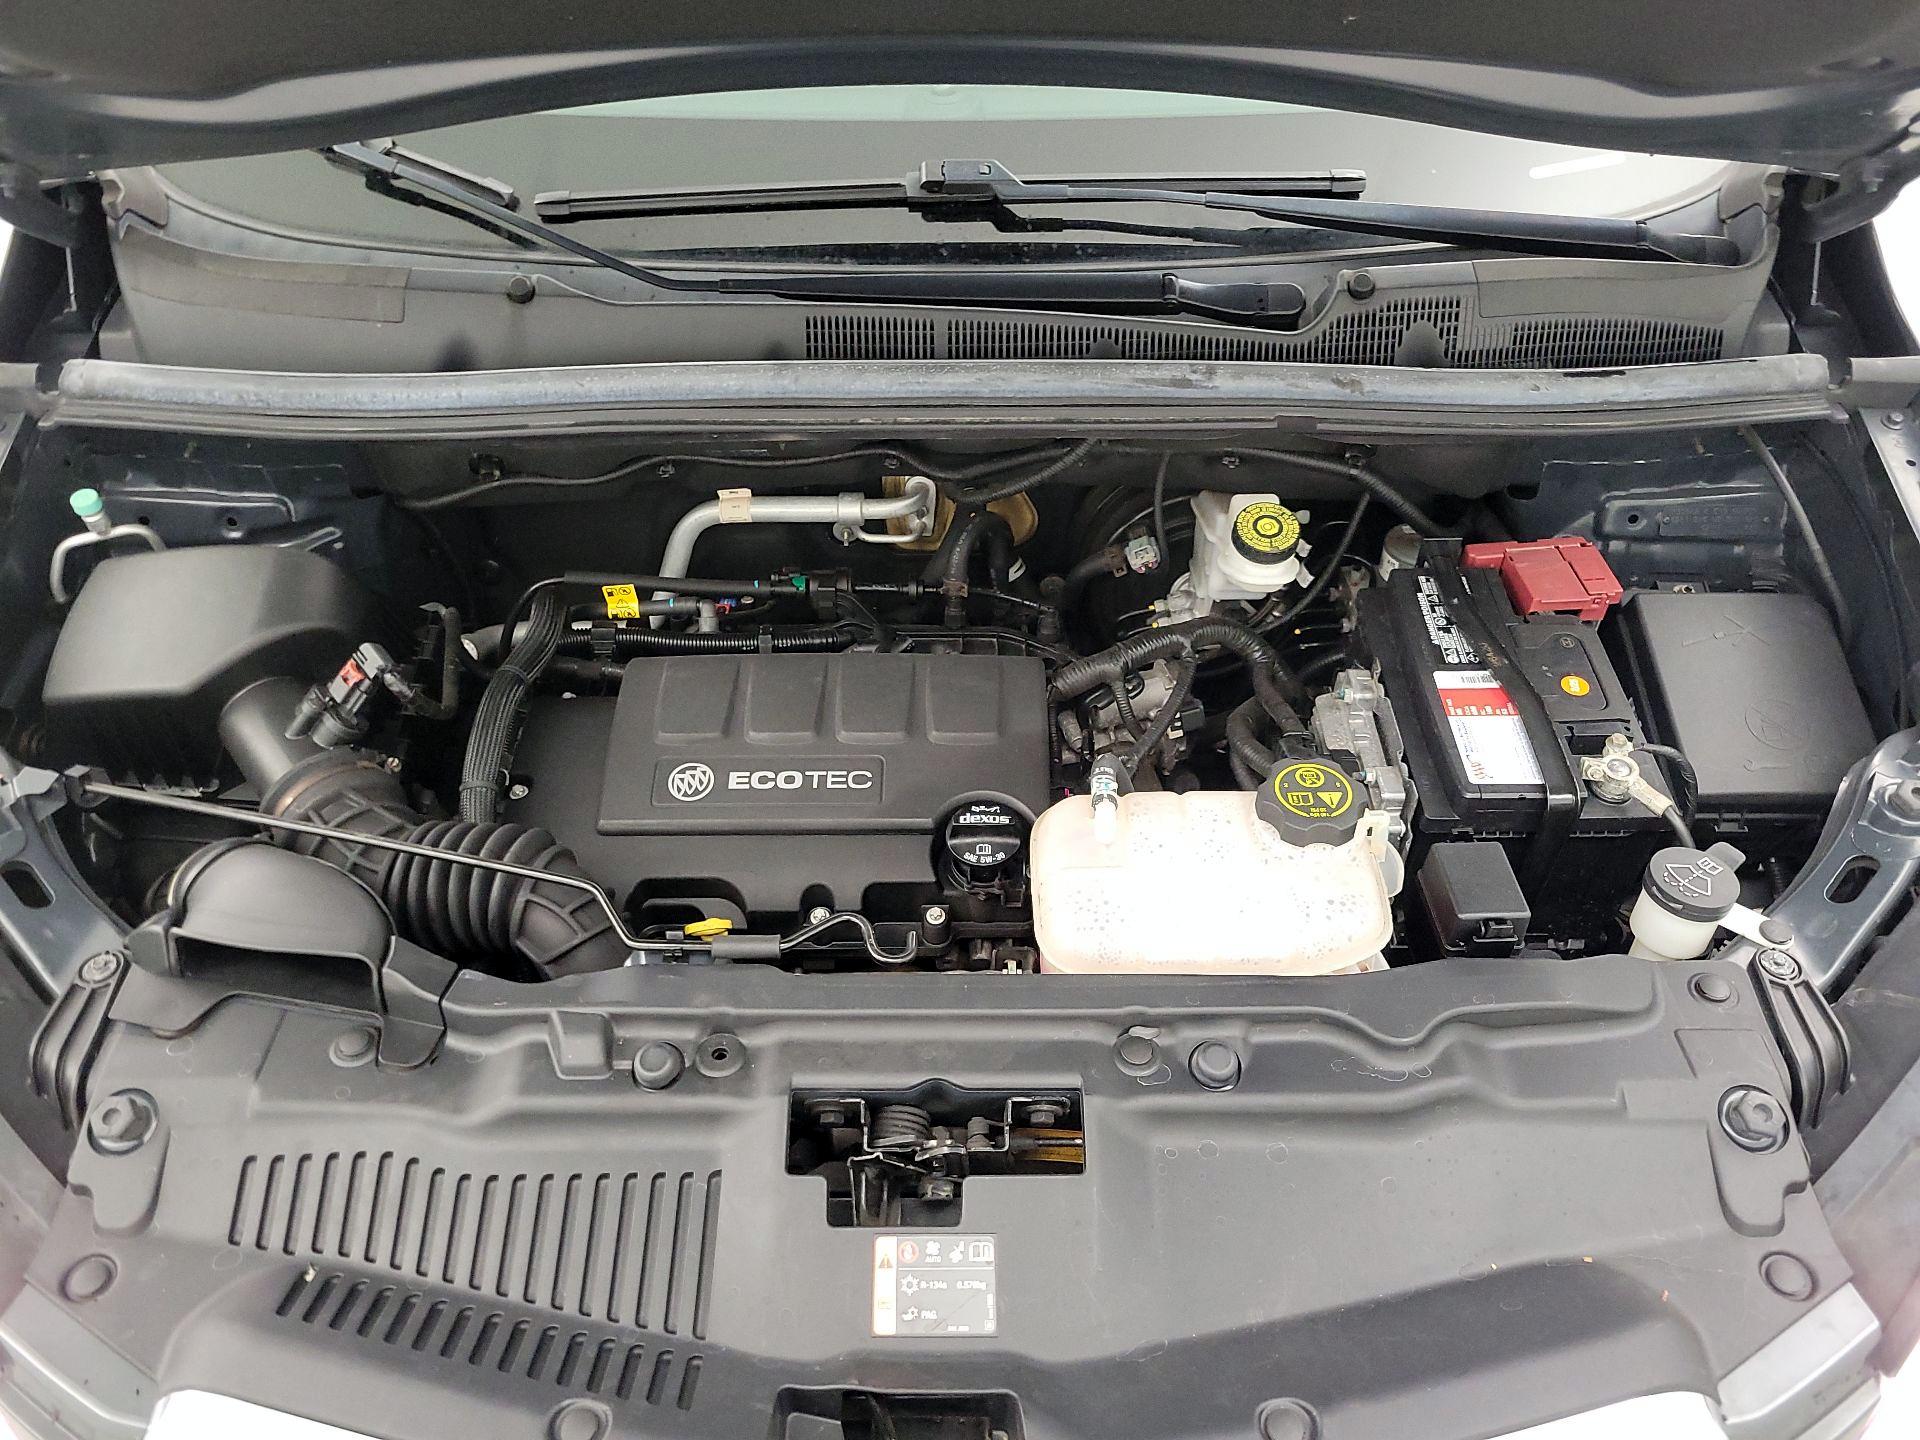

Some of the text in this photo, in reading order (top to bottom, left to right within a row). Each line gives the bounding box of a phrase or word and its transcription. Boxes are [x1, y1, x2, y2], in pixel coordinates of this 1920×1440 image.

[728, 770, 873, 790] ECOTEC
[959, 812, 1012, 824] dexos
[963, 852, 979, 863] SAE
[925, 1255, 942, 1263] AUTO
